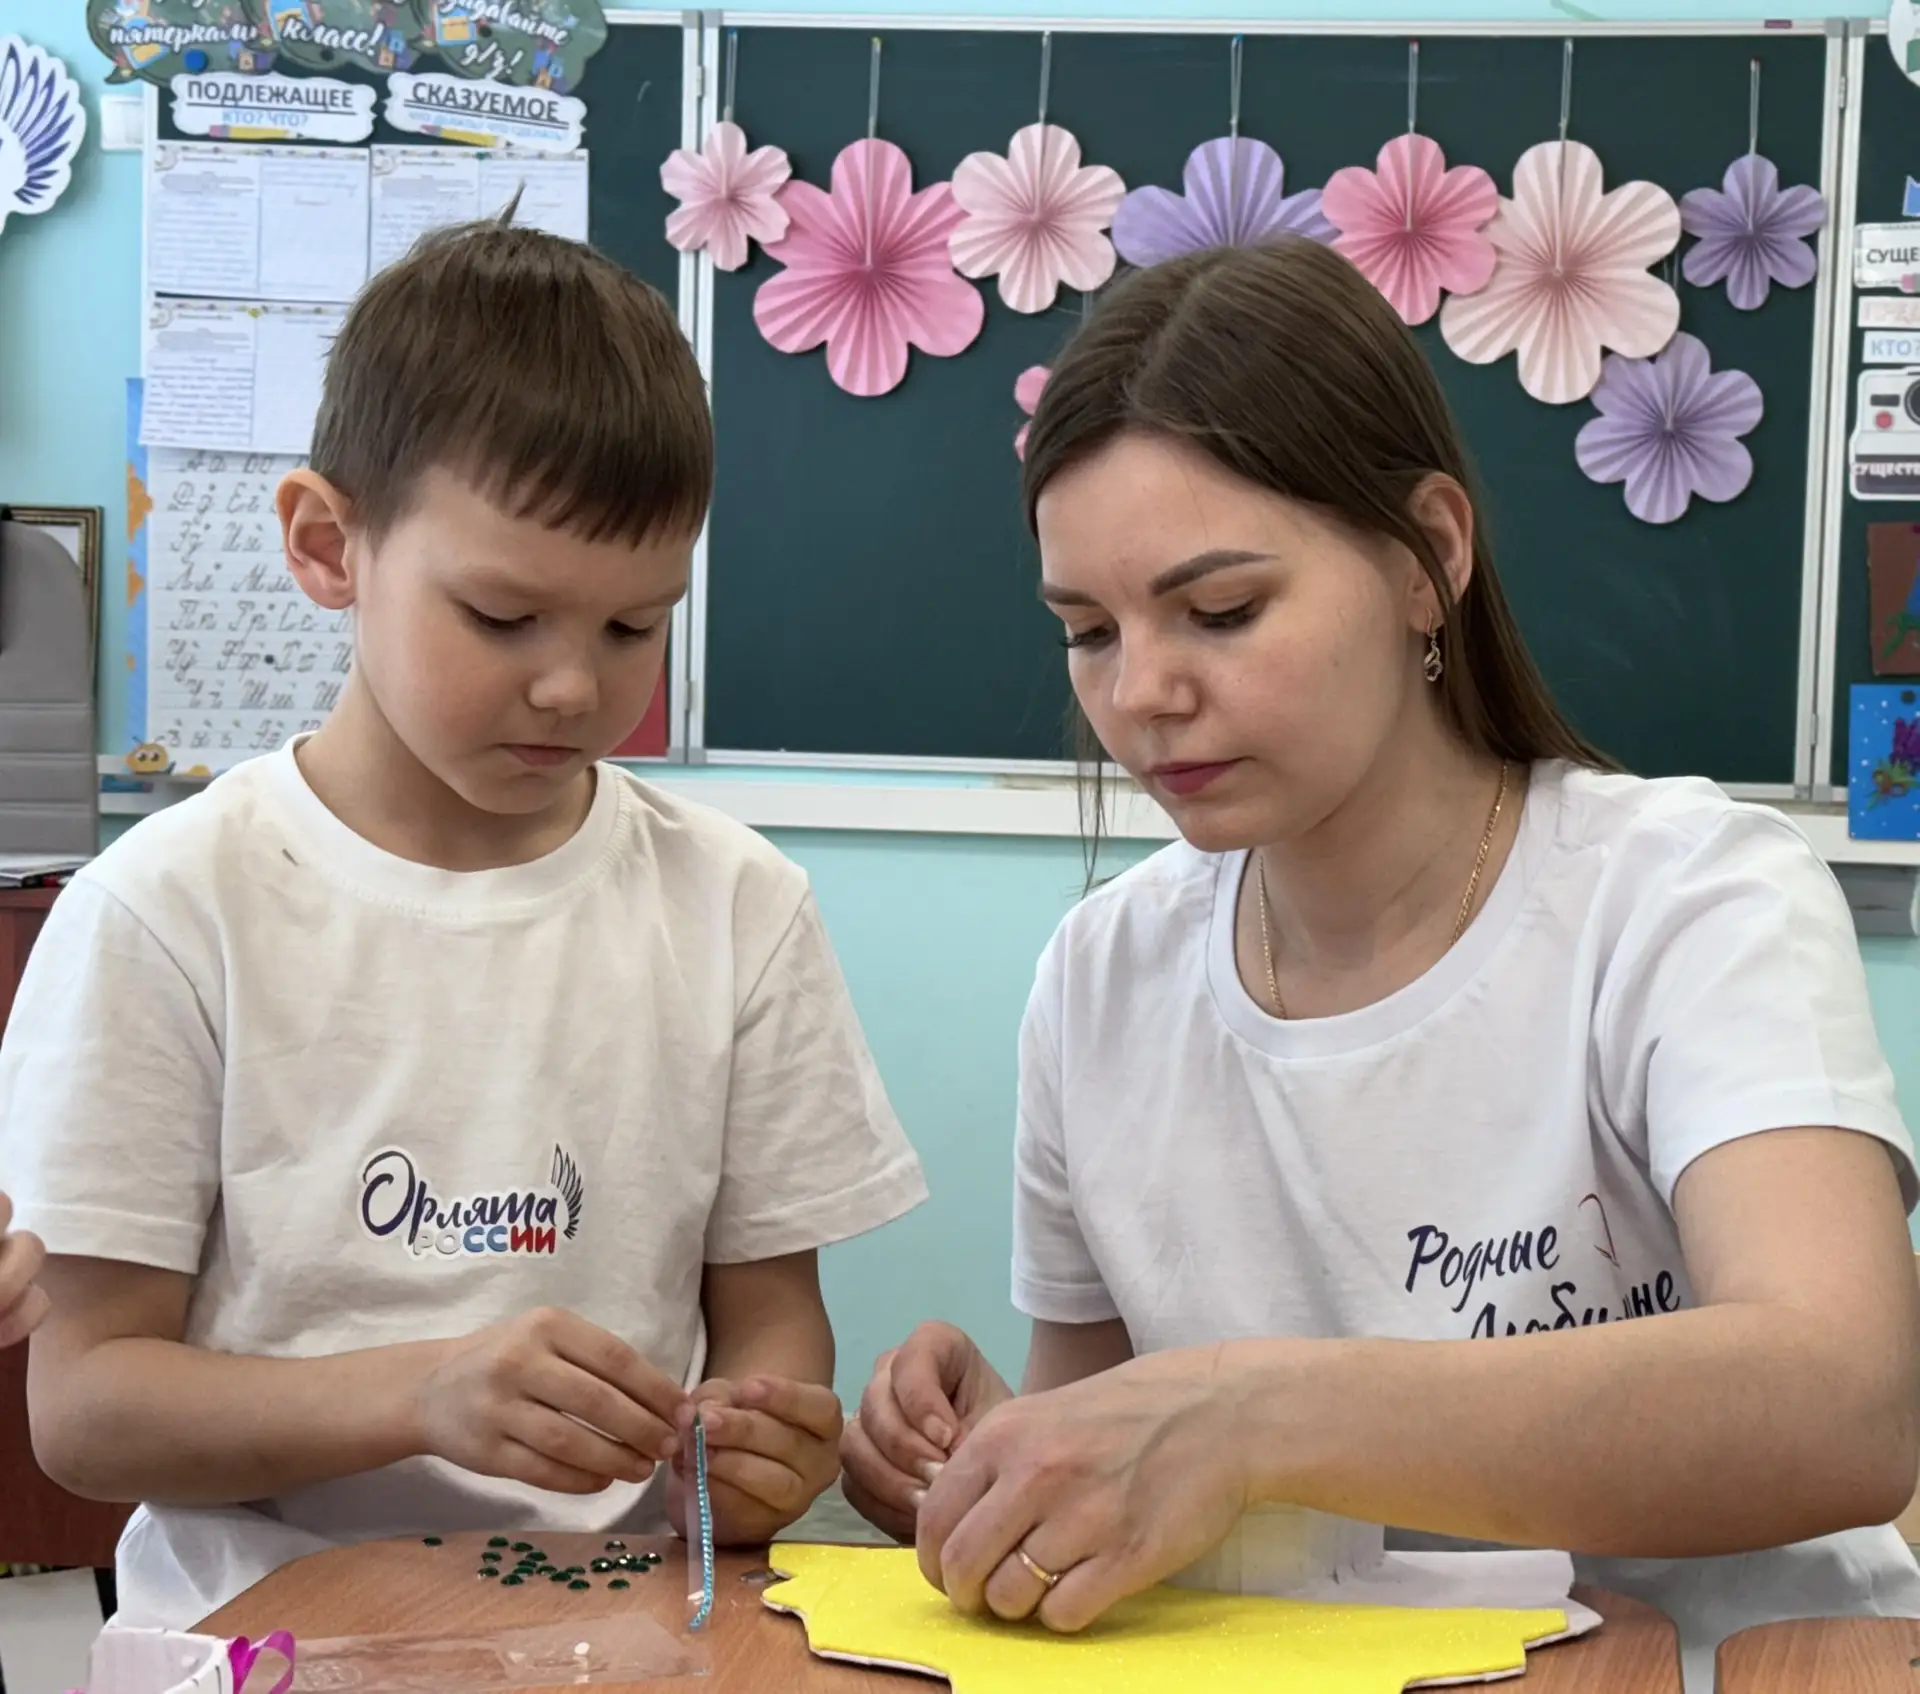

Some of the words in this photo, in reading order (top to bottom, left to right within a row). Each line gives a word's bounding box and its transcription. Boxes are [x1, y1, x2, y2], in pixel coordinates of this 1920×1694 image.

[281, 16, 385, 56] класс!
[187, 80, 354, 112] ПОДЛЕЖАЩЕЕ
[411, 81, 560, 121] СКАЗУЕМОЕ
[221, 110, 264, 125] КТО?
[267, 112, 309, 127] ЧТО?
[362, 1150, 558, 1246] Орлята
[412, 1225, 556, 1255] РОССИИ
[1404, 1224, 1560, 1313] Родные
